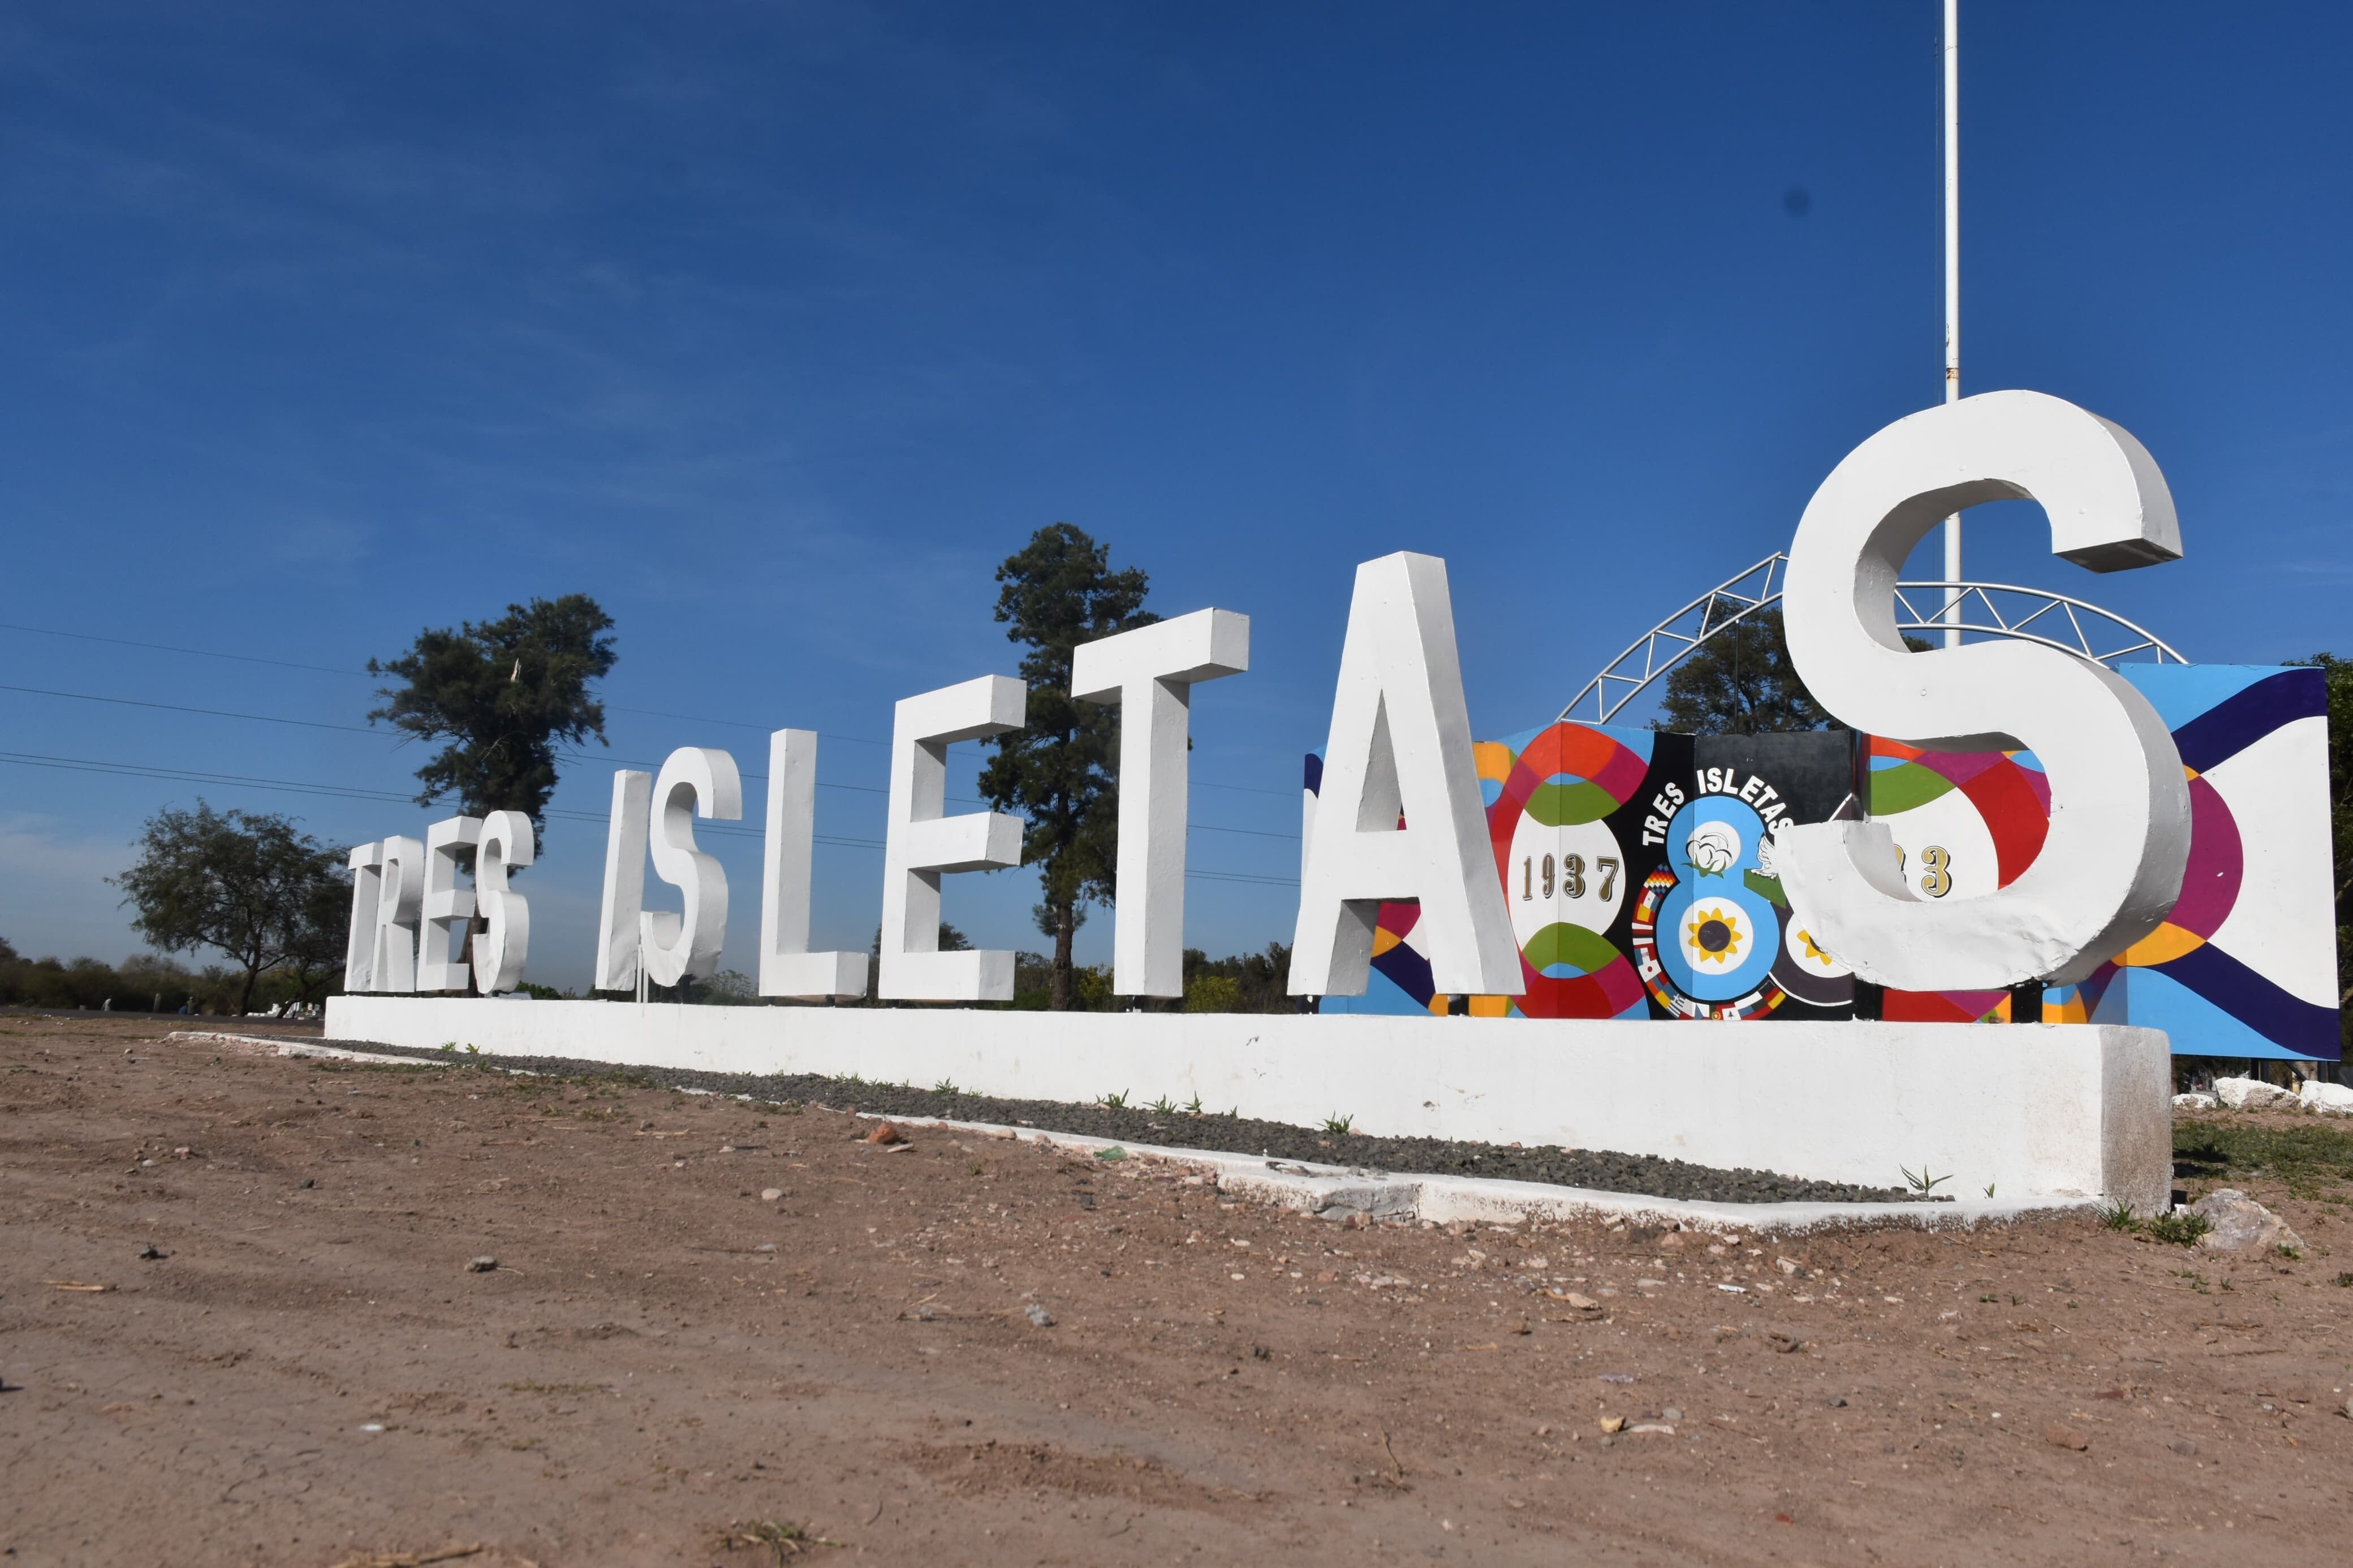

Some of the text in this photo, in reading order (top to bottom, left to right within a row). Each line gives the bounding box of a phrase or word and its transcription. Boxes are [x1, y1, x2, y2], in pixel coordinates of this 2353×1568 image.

[344, 389, 2192, 1000] TRES ISLETAS
[1642, 782, 1684, 846] TRES
[1522, 853, 1619, 902] 1937
